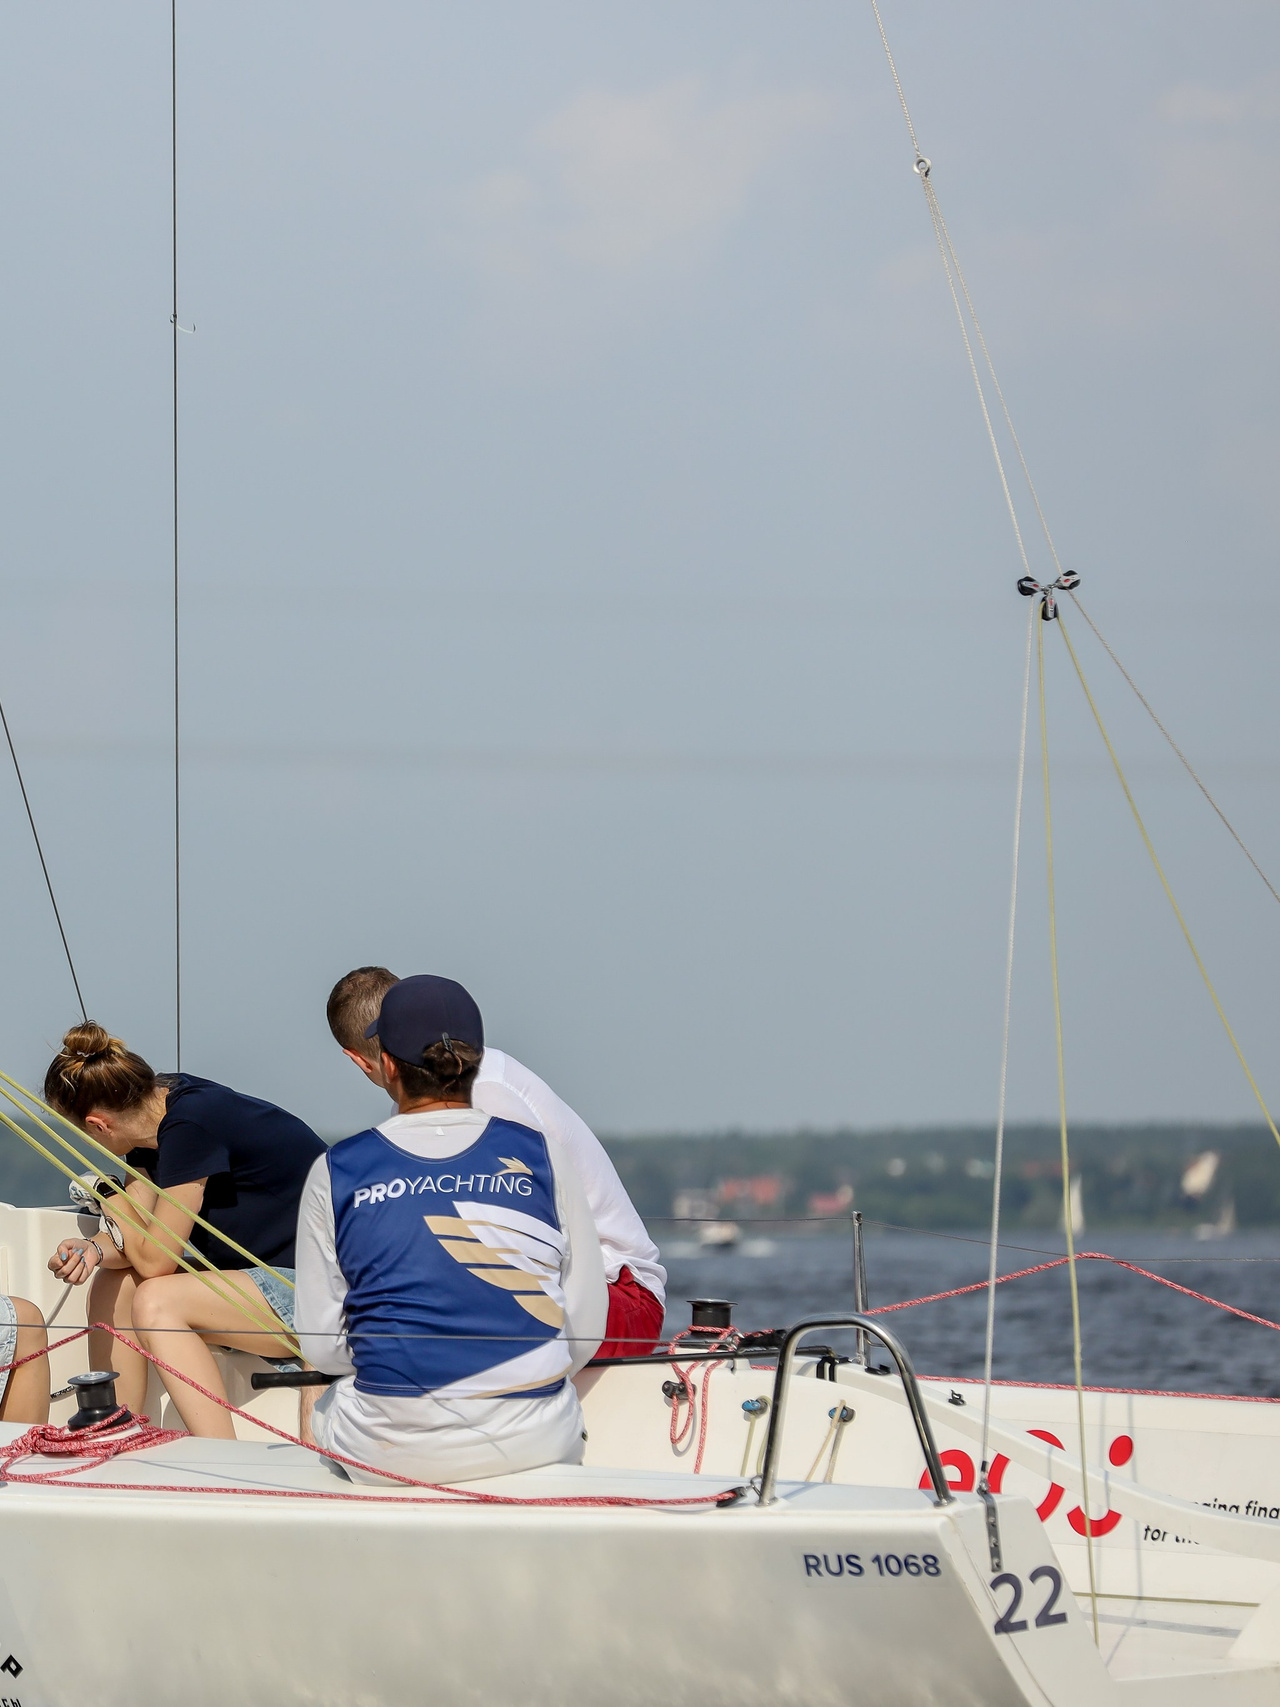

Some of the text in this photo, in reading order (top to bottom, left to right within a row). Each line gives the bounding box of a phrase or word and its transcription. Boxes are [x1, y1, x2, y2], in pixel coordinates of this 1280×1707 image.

[353, 1174, 534, 1208] PROYACHTING
[803, 1554, 942, 1577] RUS 1068
[989, 1565, 1069, 1636] 22
